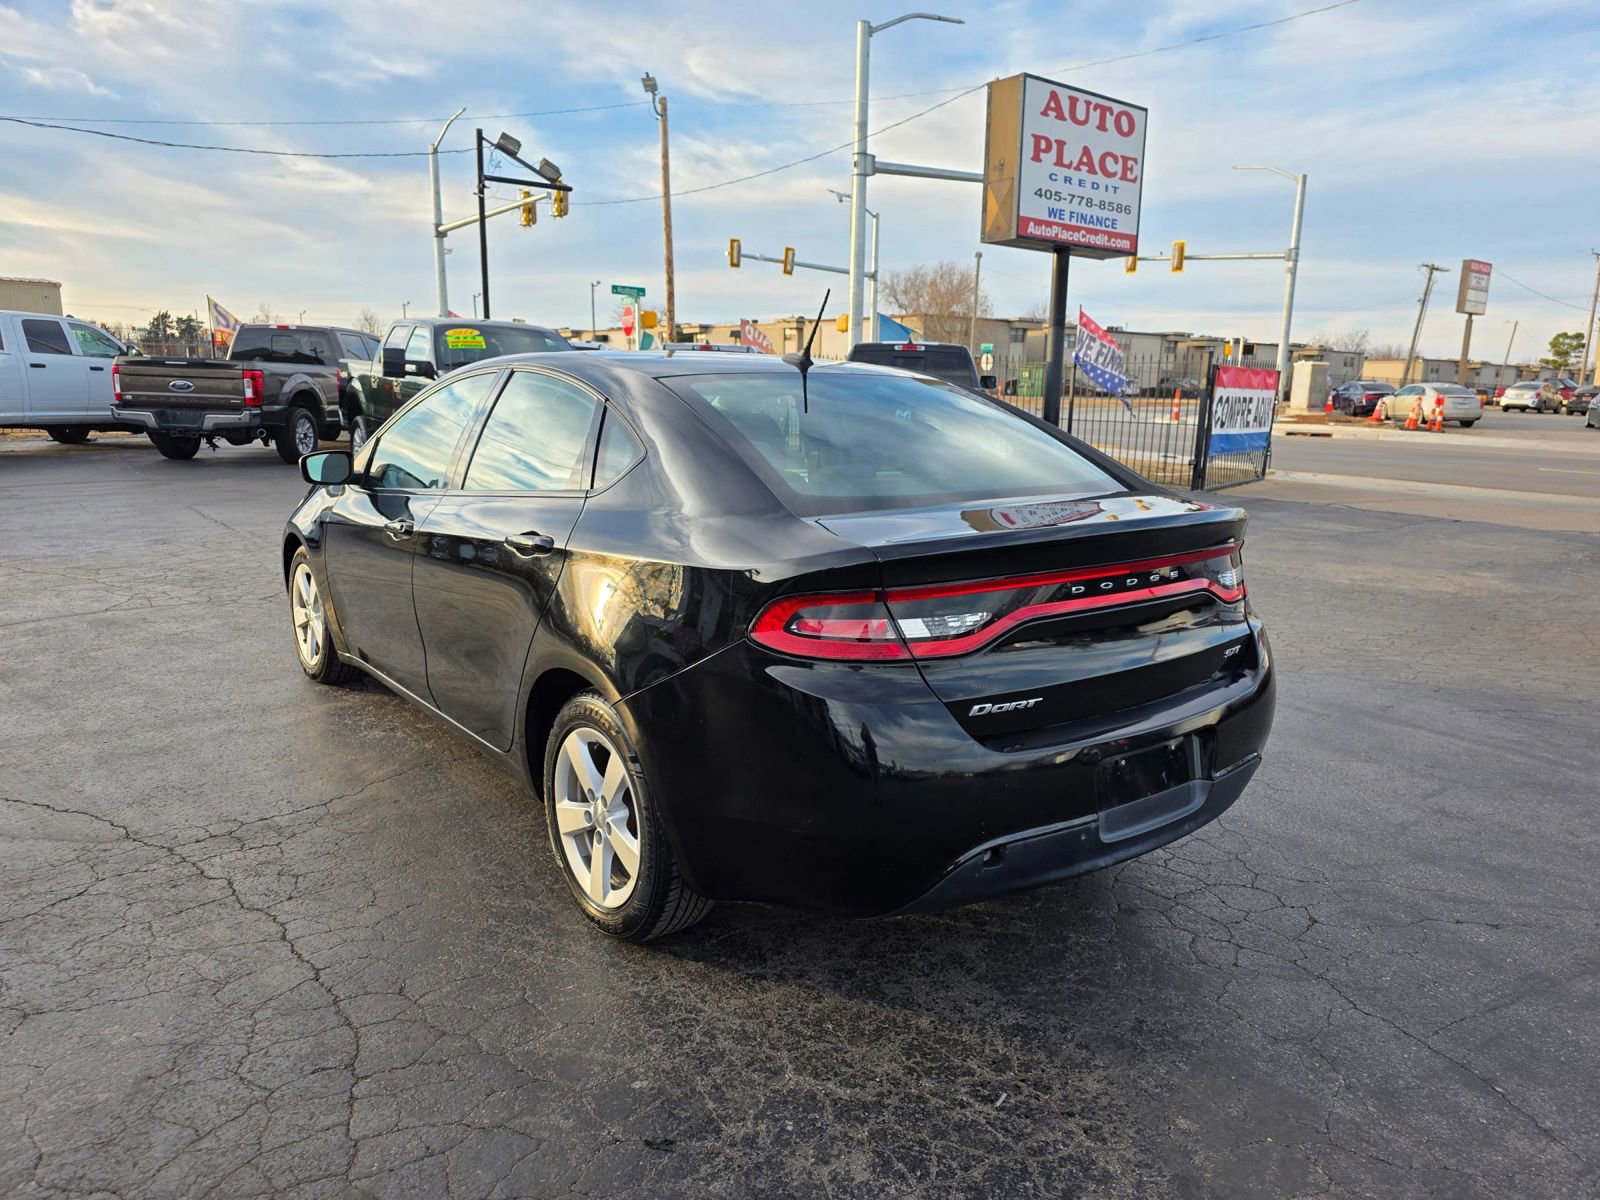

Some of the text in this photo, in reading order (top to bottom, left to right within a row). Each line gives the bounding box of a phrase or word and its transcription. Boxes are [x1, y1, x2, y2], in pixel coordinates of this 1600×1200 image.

[1040, 90, 1136, 138] AUTO
[1030, 133, 1138, 184] PLACE
[1048, 172, 1120, 194] CREDIT
[1034, 187, 1132, 215] 405-778-8586
[1047, 206, 1118, 230] WE FINANCE
[1027, 222, 1130, 249] AutoPlaceCredit.com
[1214, 395, 1253, 429] COMPRE
[1072, 570, 1179, 594] DODGE
